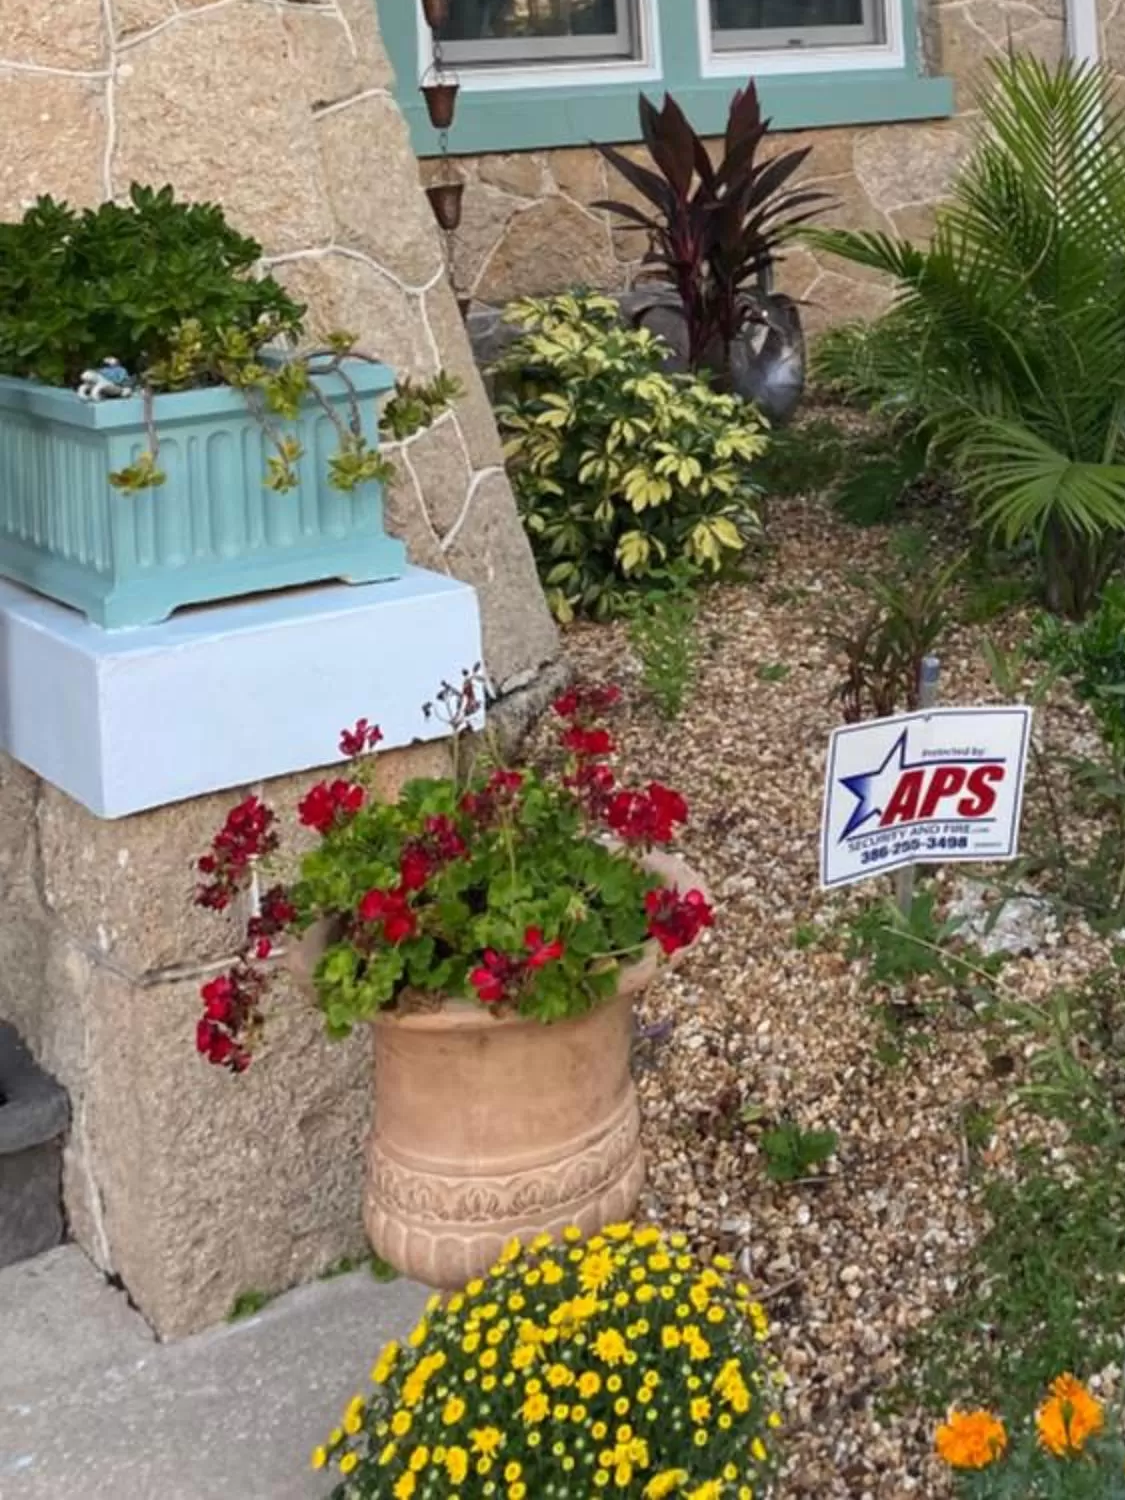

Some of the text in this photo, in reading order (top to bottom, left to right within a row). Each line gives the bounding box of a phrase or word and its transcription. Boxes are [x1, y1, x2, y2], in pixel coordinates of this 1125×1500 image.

[878, 764, 1006, 827] APS
[847, 830, 909, 851] SECURITY
[910, 824, 941, 835] AND
[943, 823, 971, 835] FIRE
